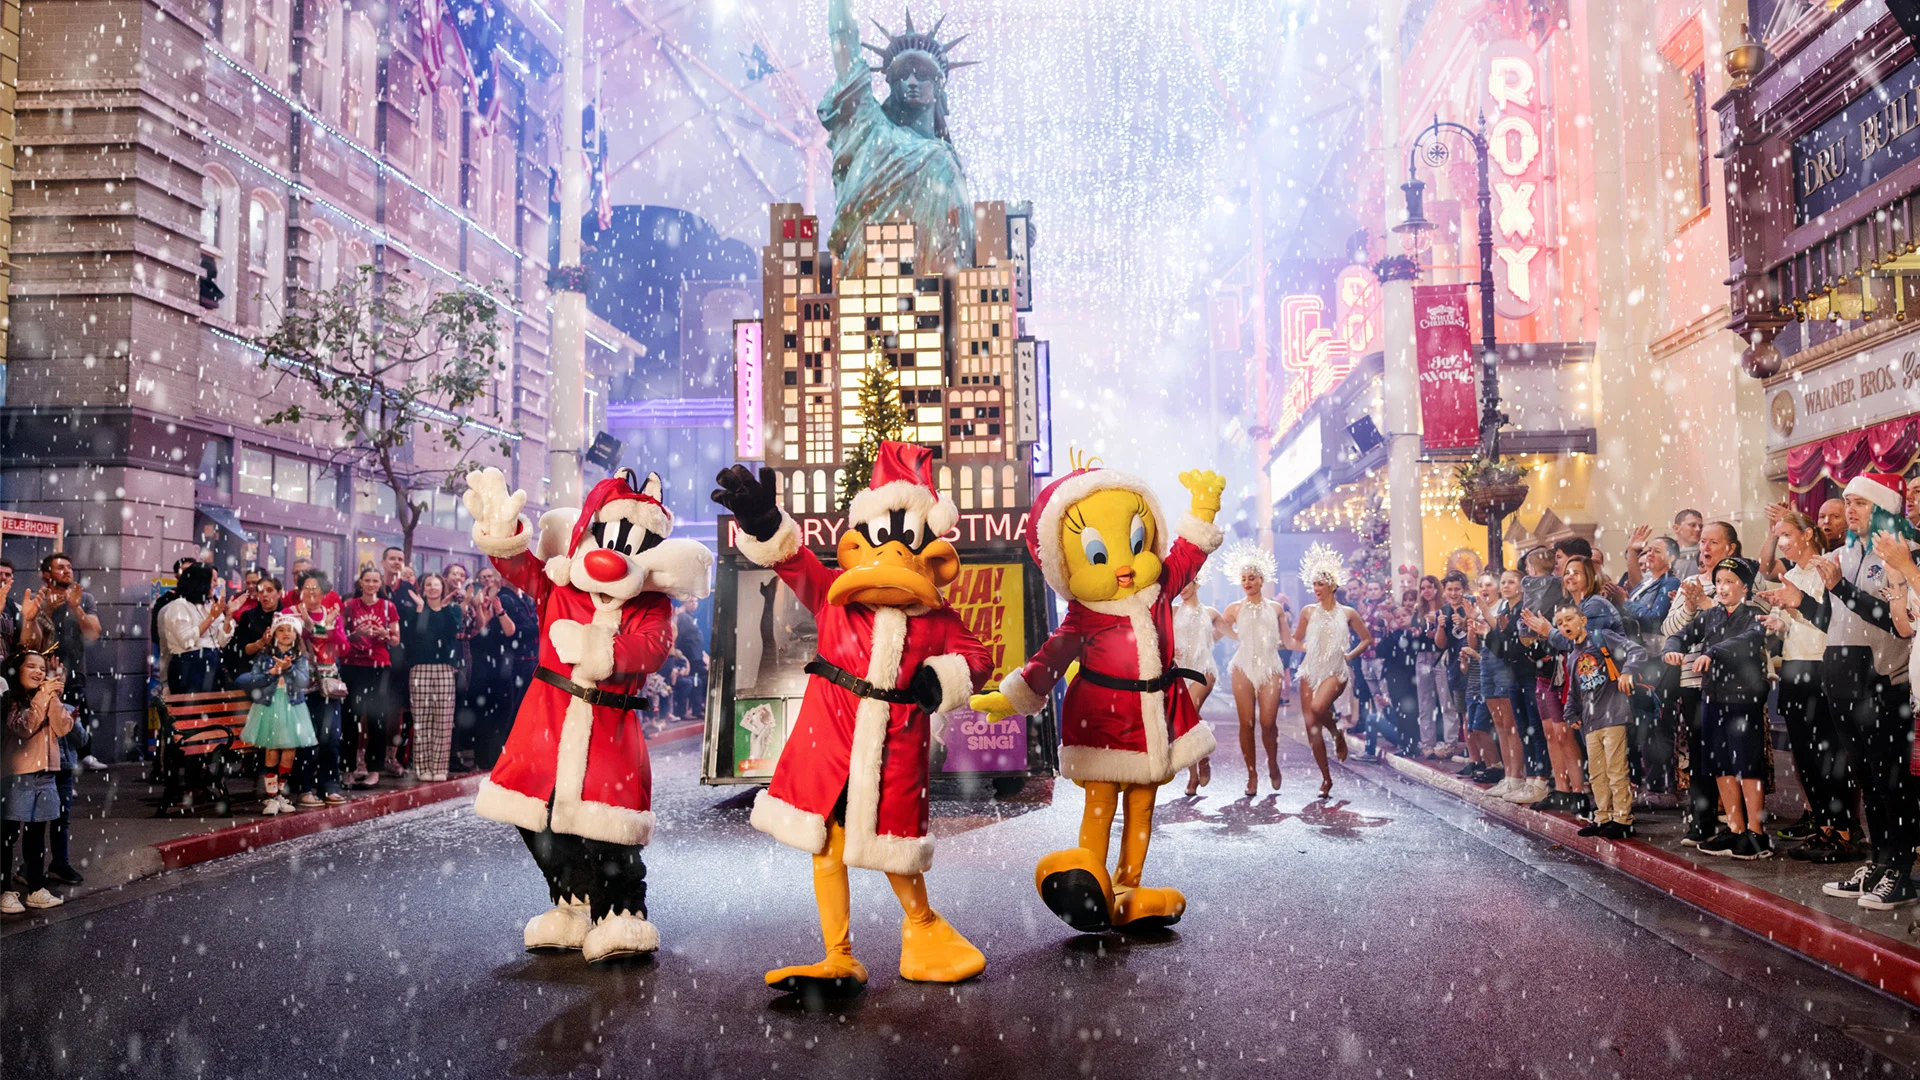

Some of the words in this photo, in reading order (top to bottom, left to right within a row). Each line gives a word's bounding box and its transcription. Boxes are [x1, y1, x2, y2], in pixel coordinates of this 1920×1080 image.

[1803, 135, 1848, 198] DRU
[1488, 56, 1541, 305] ROXY
[1419, 368, 1474, 384] World
[1804, 378, 1856, 416] WARNER
[1860, 364, 1896, 399] BROS.
[3, 518, 56, 534] TELEPHONE
[948, 567, 1004, 605] HA!
[960, 720, 1021, 735] GOTTA
[967, 735, 1014, 751] SING!
